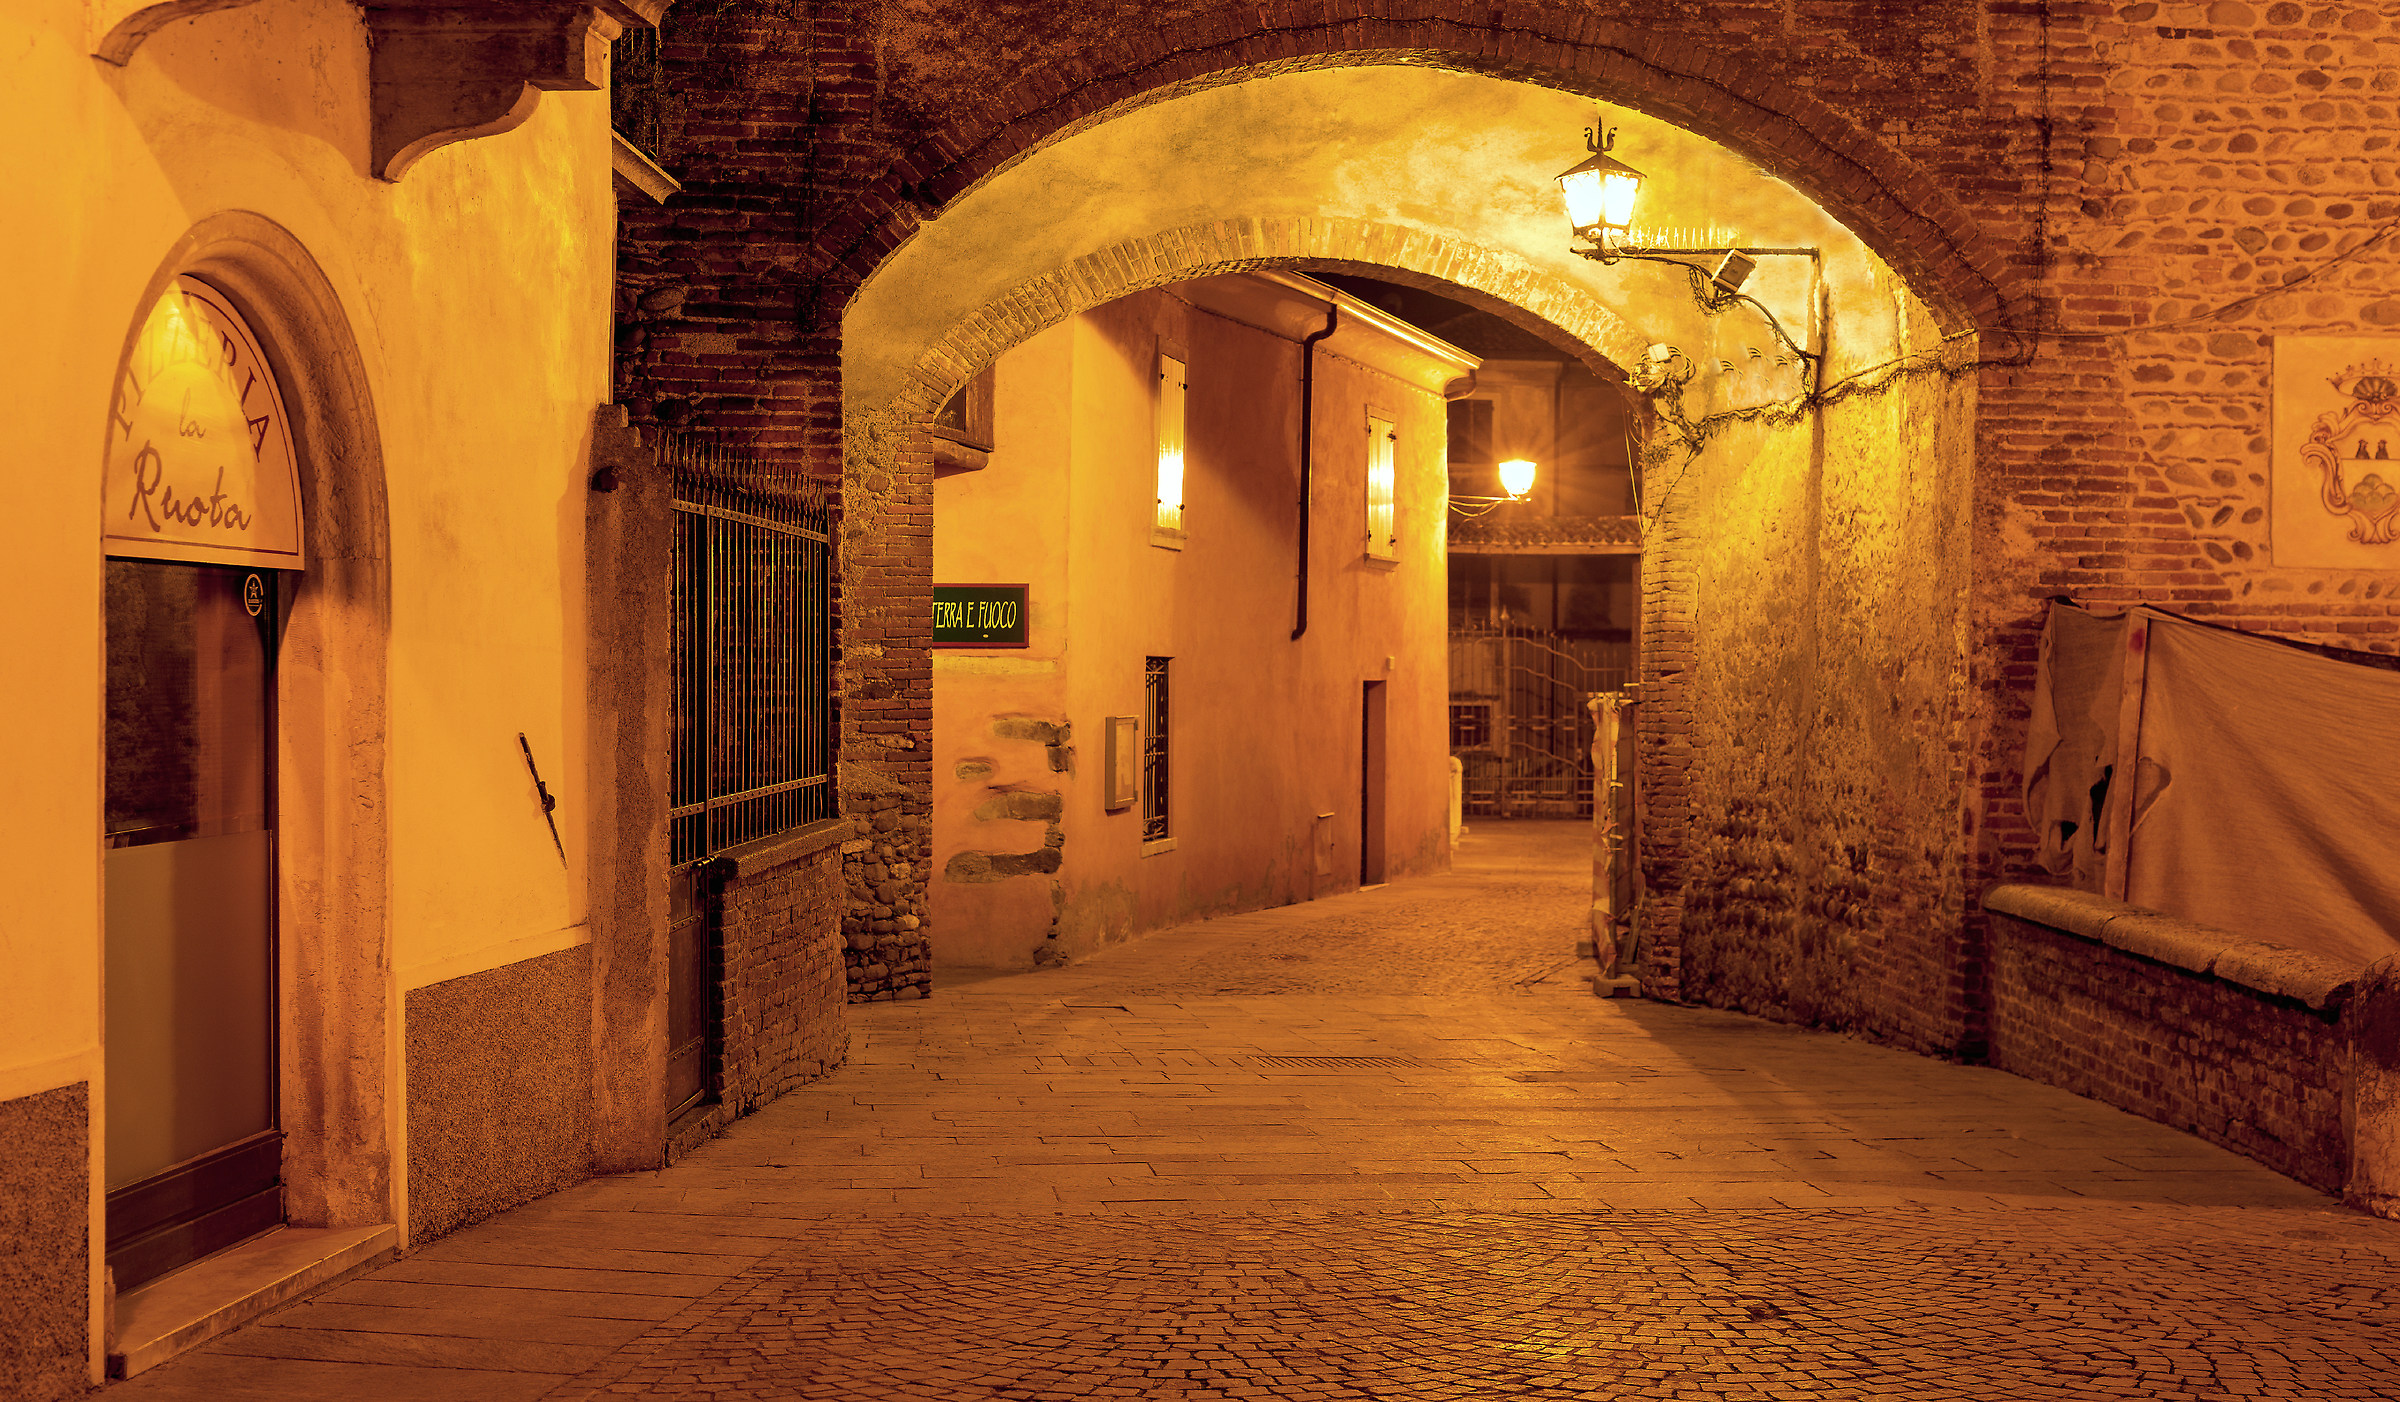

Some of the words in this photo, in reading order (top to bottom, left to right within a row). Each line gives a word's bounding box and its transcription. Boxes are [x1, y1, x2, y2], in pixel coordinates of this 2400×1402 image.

[113, 311, 269, 463] PIZZERIA
[179, 387, 206, 439] la
[129, 439, 252, 533] Ruota
[966, 601, 975, 628] E
[978, 601, 1017, 629] FUOCO
